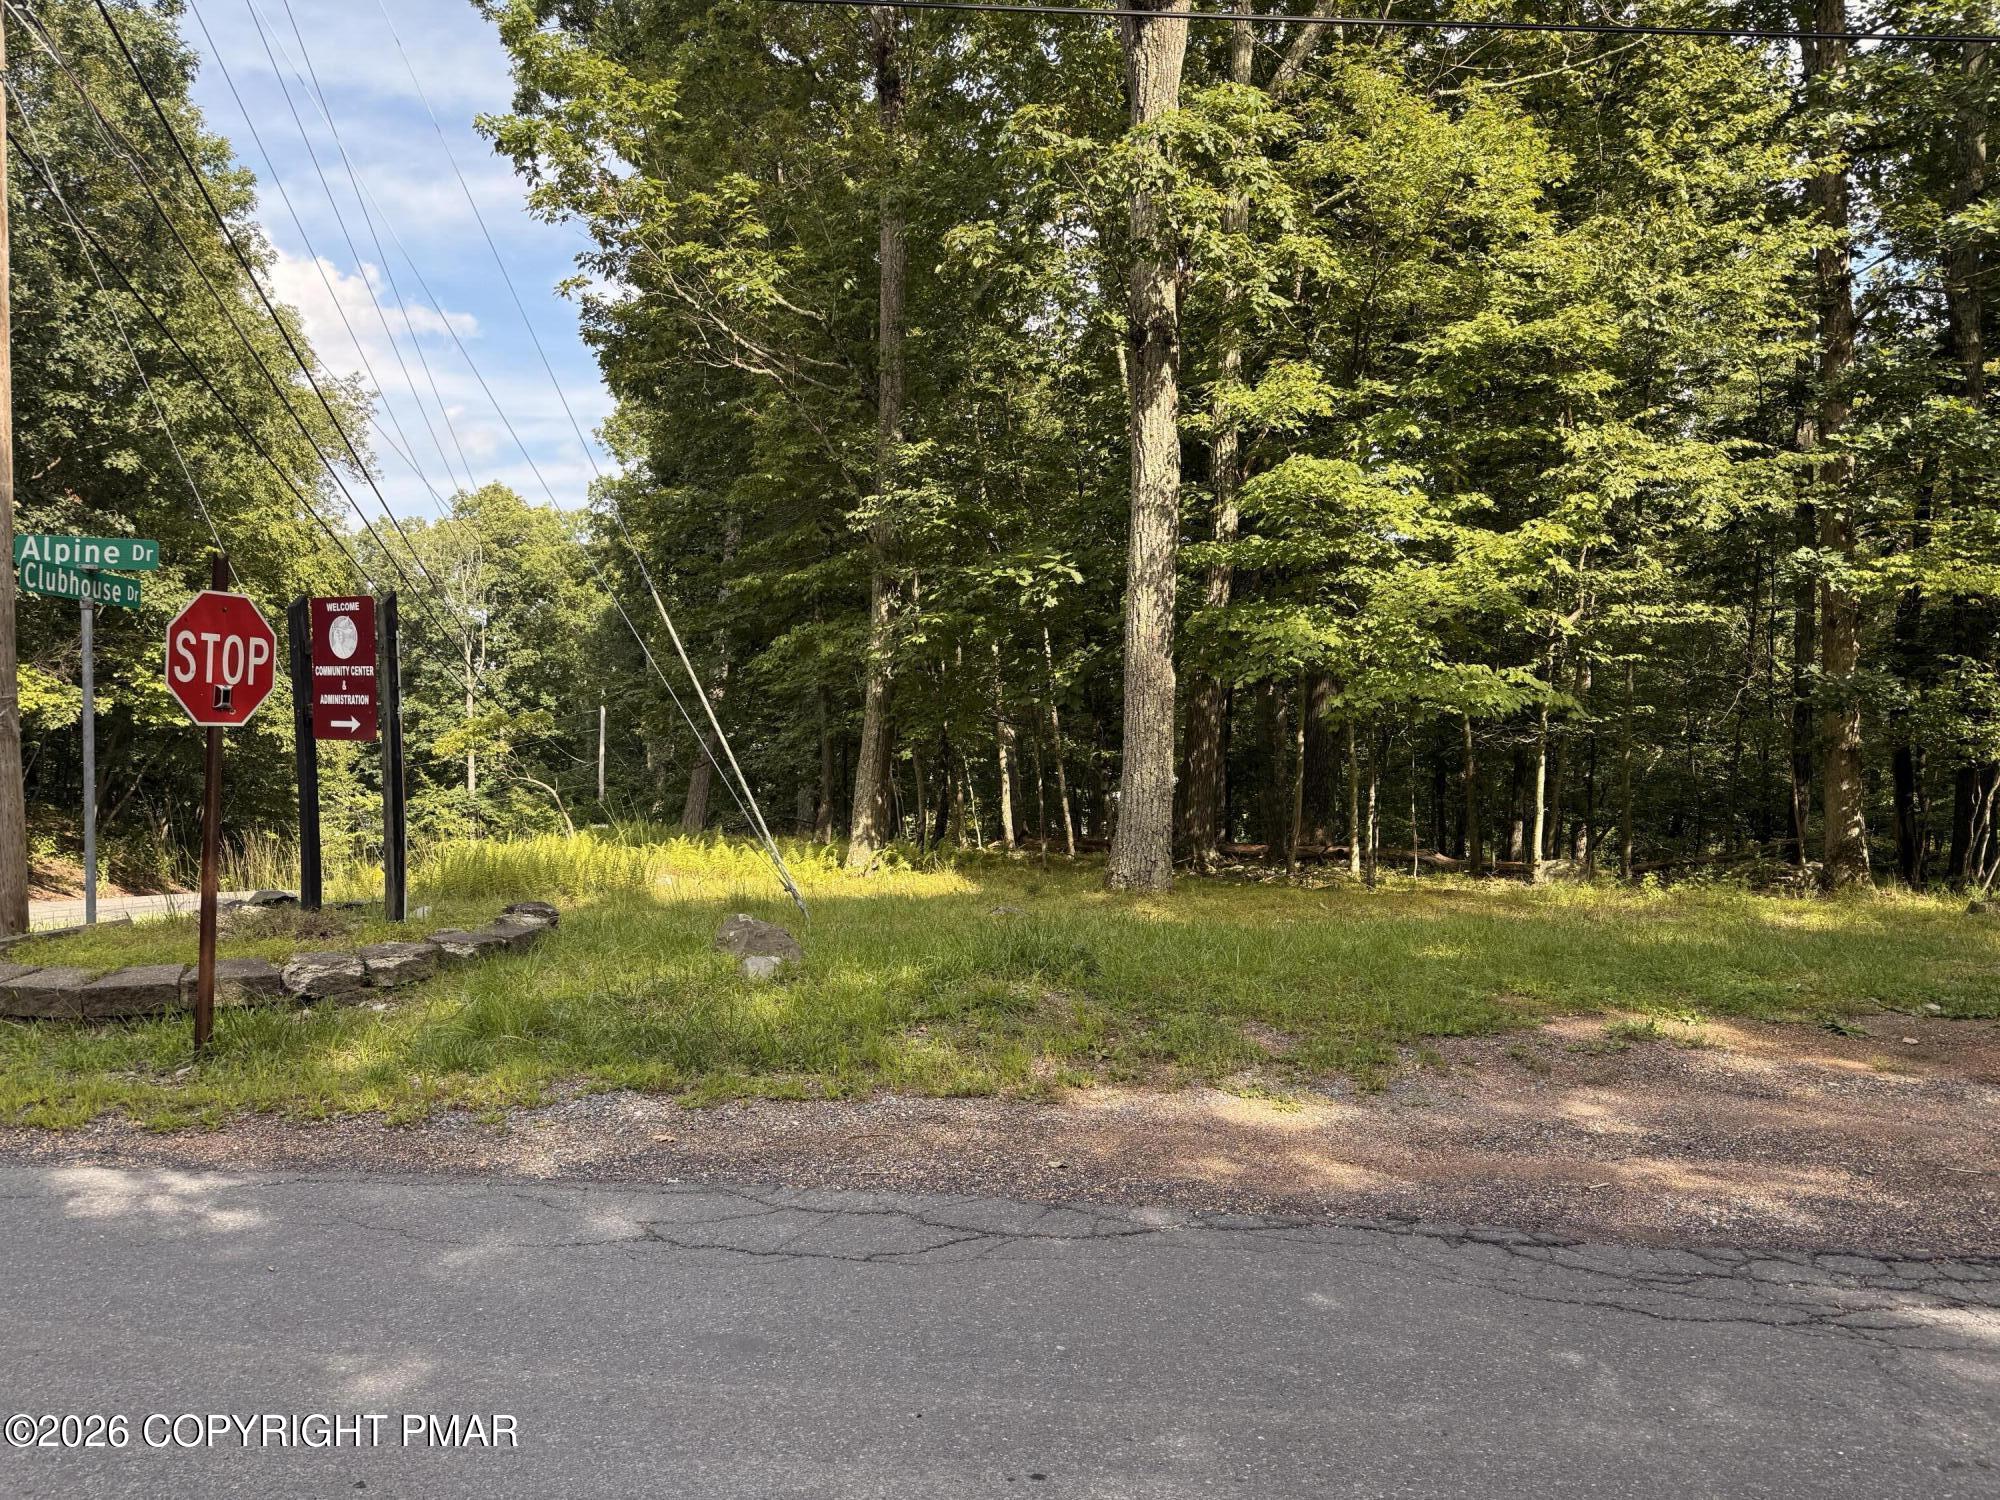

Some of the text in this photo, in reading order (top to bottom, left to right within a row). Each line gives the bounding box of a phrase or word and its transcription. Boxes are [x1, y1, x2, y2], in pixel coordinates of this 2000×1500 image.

[22, 535, 154, 565] Alpine Dr
[24, 561, 139, 603] Clubhouse Dr
[326, 602, 360, 612] WELCOME
[174, 630, 270, 686] STOP
[315, 665, 374, 676] COMMUNITY CENTER
[341, 680, 347, 690] &
[320, 694, 369, 705] ADMINISTRATION
